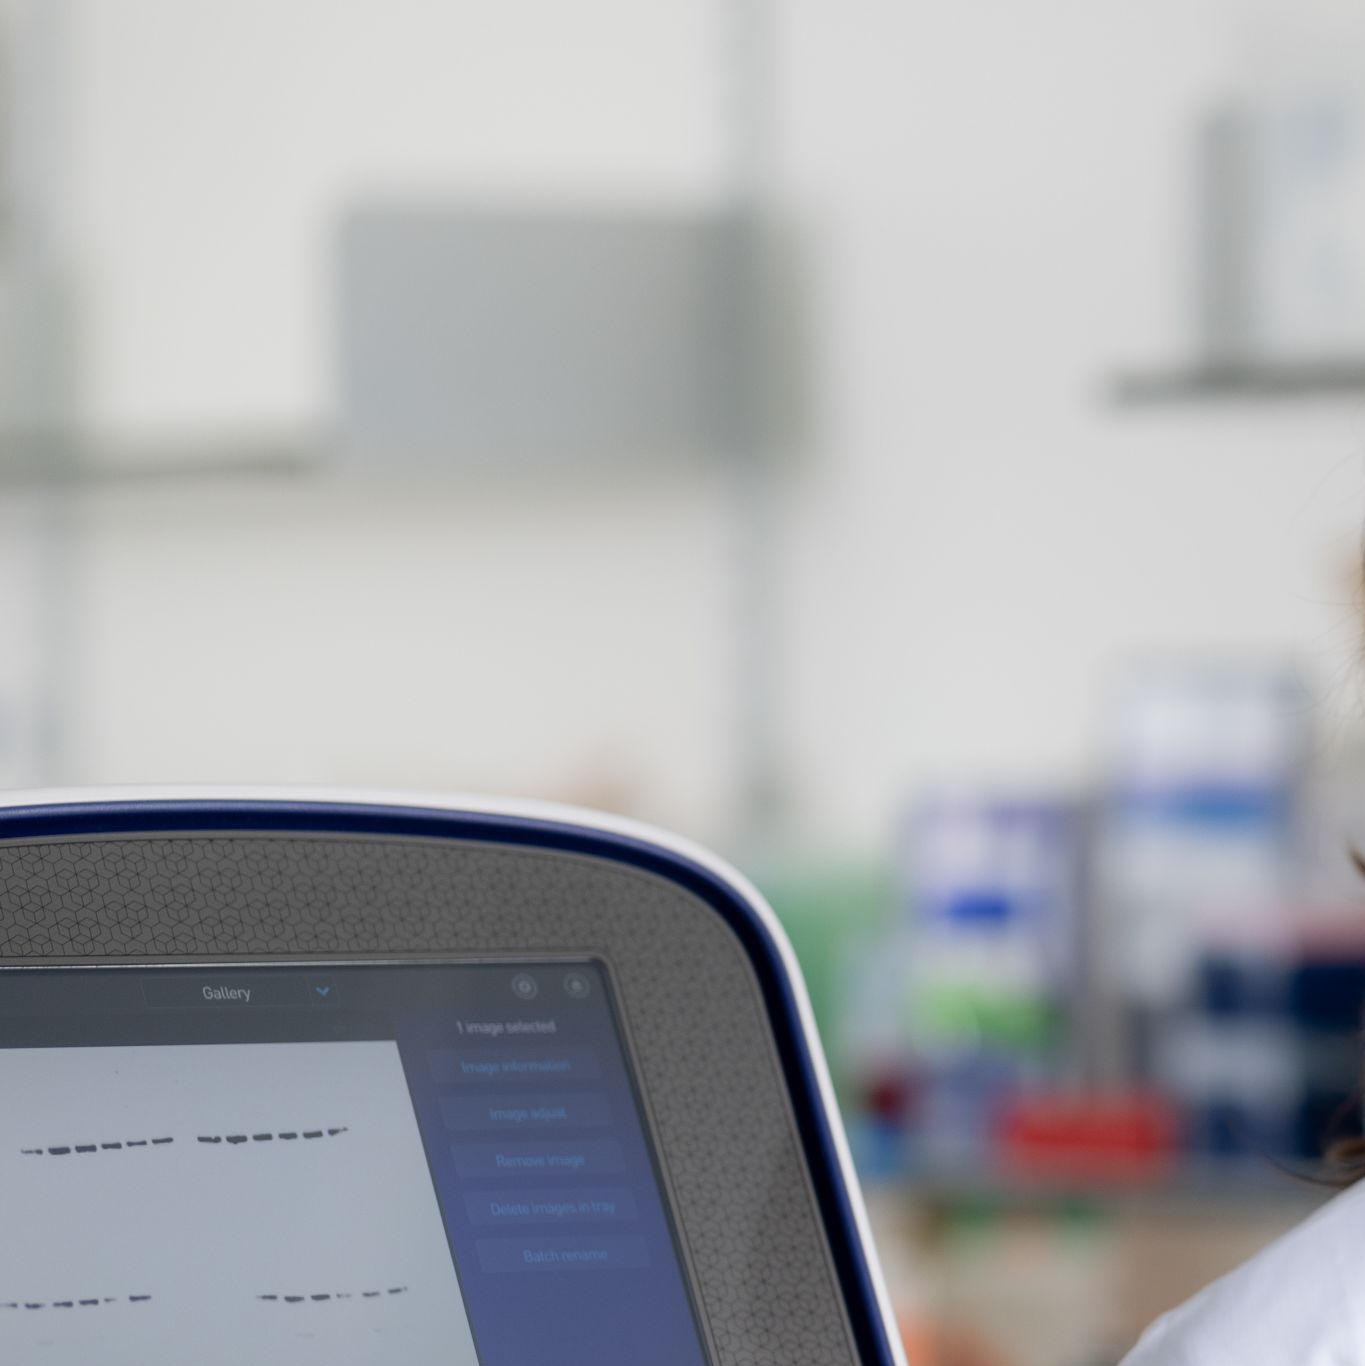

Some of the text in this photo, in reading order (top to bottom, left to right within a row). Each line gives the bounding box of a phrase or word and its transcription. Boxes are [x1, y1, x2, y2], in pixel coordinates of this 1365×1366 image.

[202, 985, 252, 1002] Gallery
[456, 1019, 557, 1037] 1 image selected
[490, 1201, 530, 1216] Delete
[523, 1249, 560, 1264] Batch
